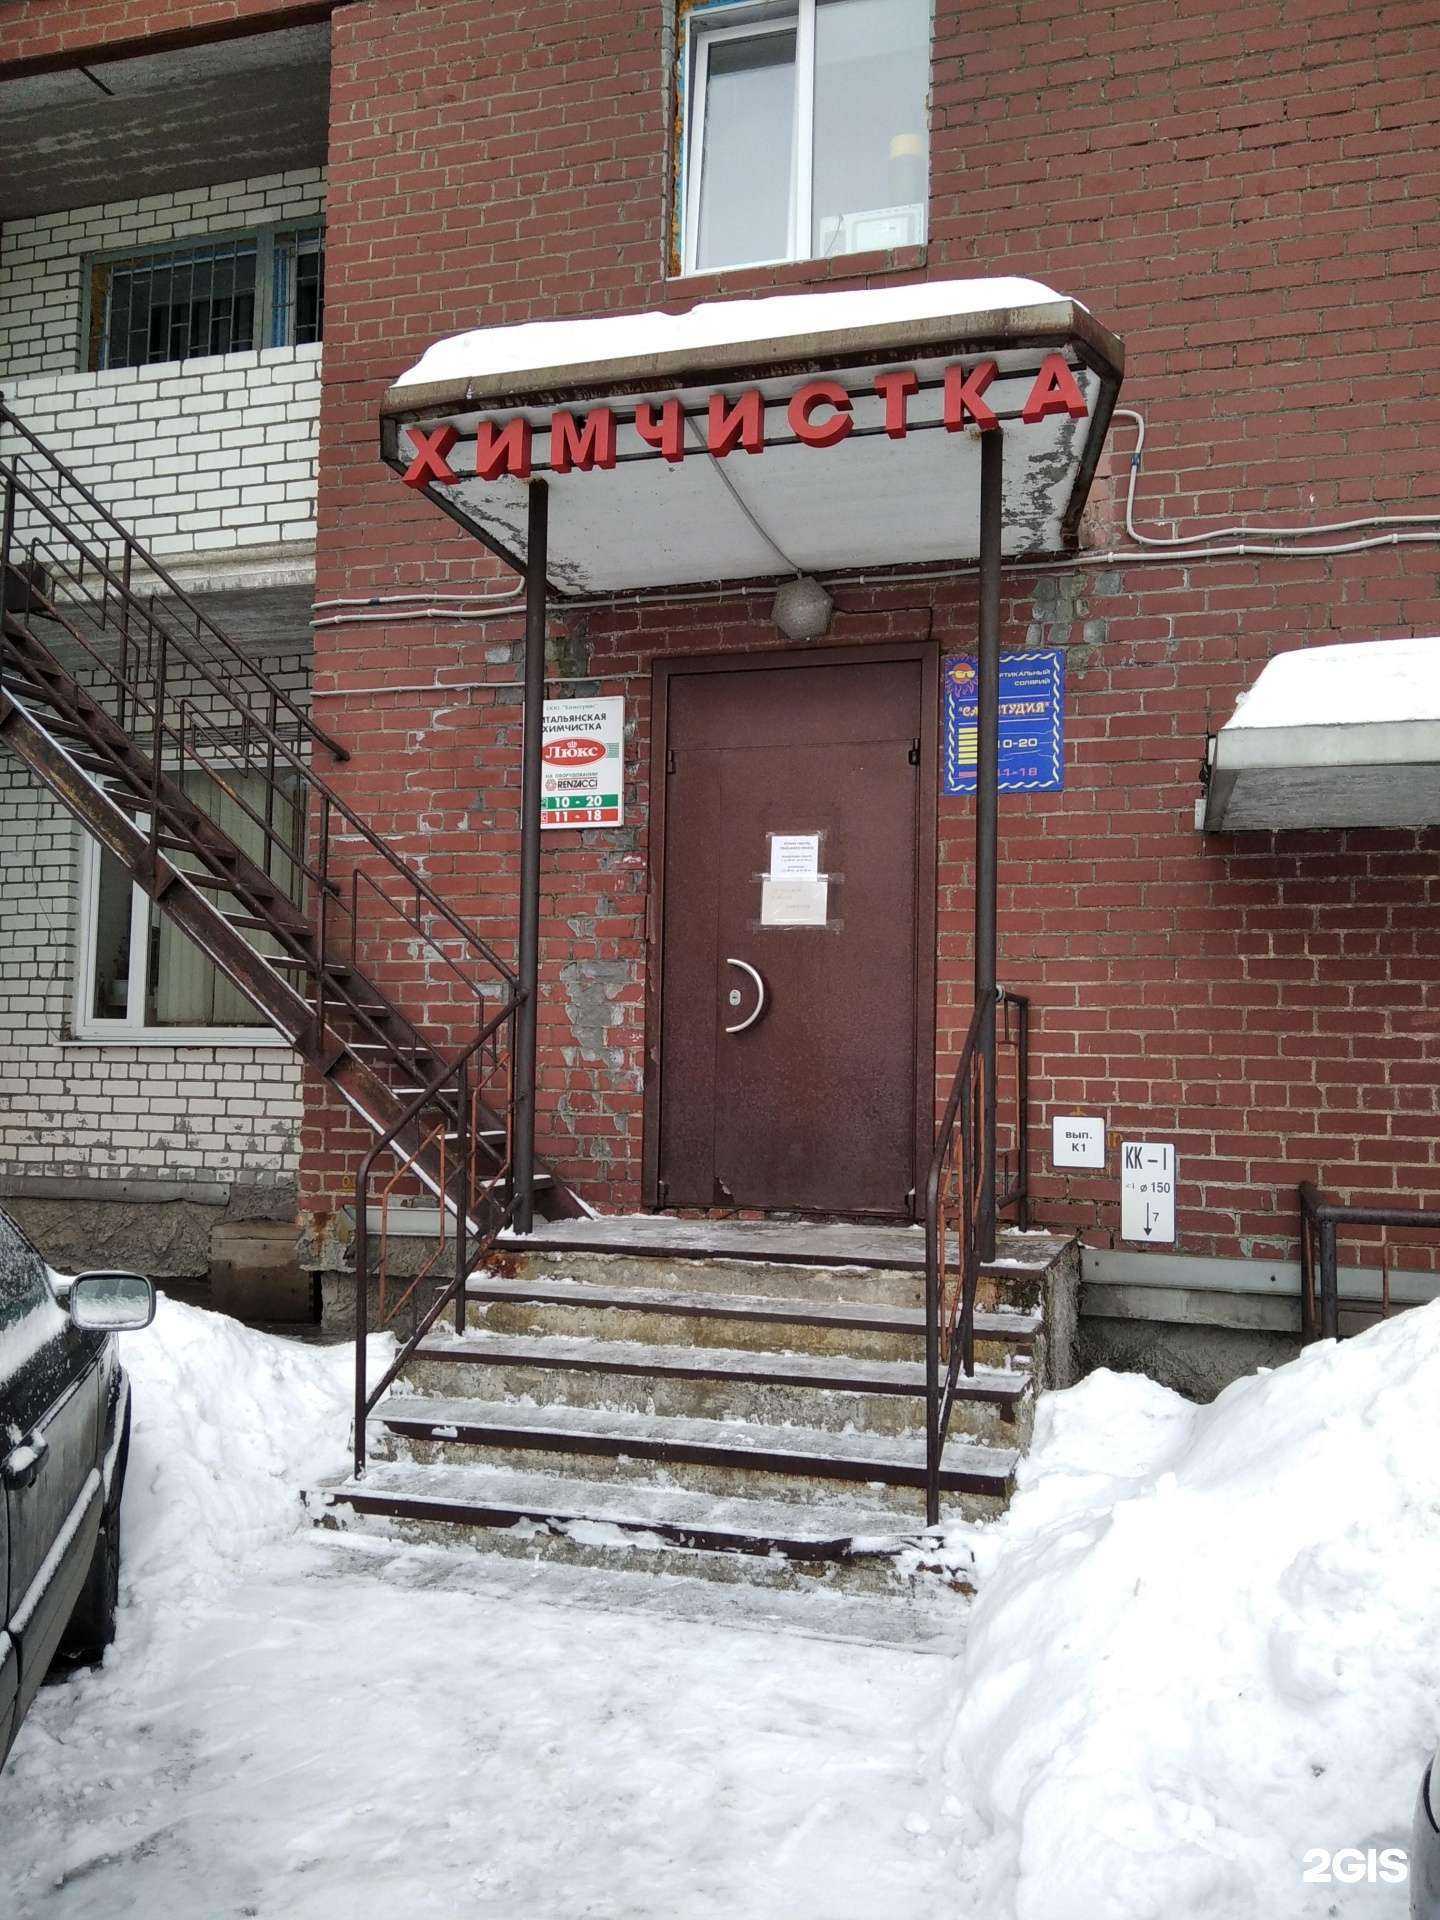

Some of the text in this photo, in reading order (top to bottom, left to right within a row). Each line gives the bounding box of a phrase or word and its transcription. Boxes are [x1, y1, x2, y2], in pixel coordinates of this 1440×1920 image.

[403, 354, 1089, 488] ХИМЧИСТКА
[543, 722, 602, 733] ХИМЧИСТКА
[558, 779, 598, 789] RENZACCI
[555, 797, 570, 808] 10
[586, 795, 603, 807] 20
[555, 812, 568, 822] 11
[586, 810, 602, 821] 18
[1151, 1182, 1171, 1194] 150
[1152, 1212, 1160, 1222] 7
